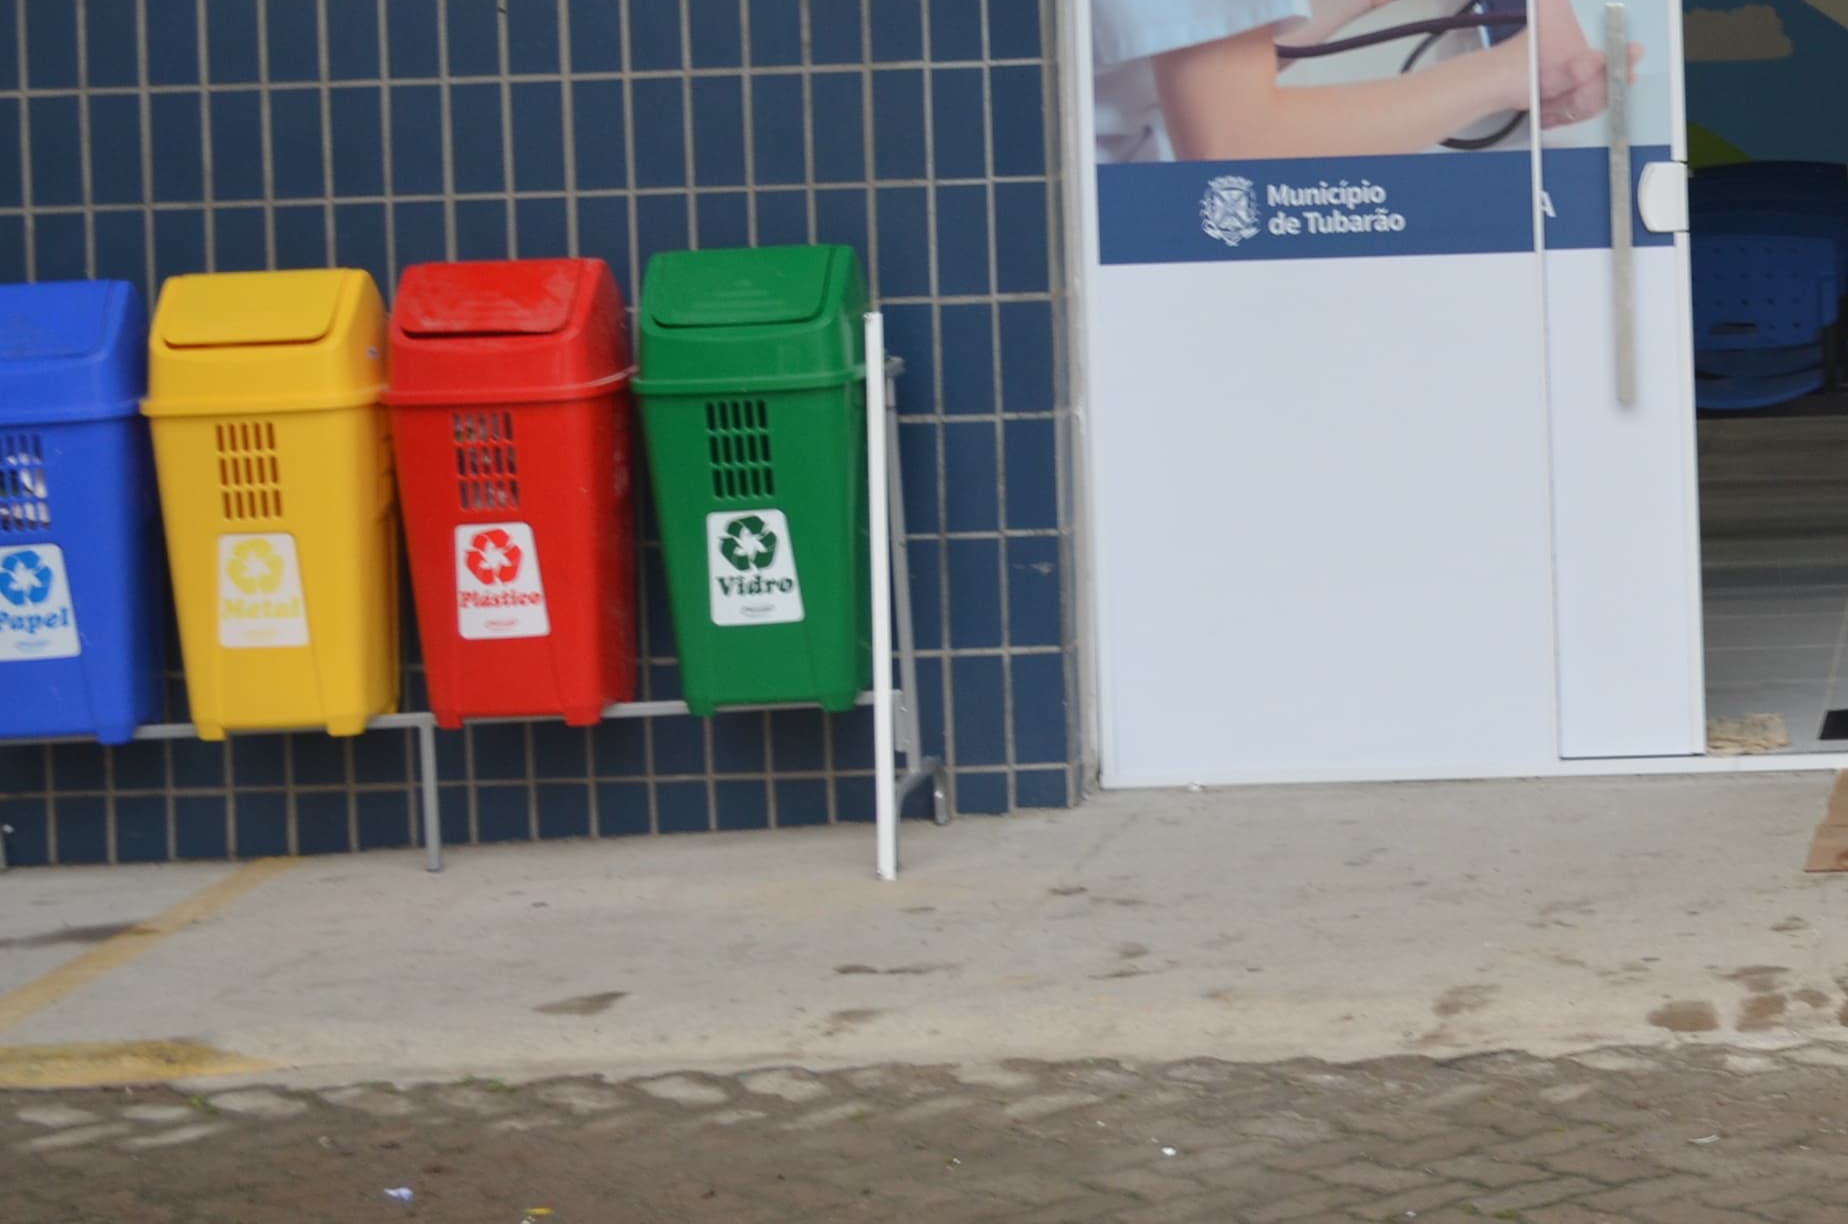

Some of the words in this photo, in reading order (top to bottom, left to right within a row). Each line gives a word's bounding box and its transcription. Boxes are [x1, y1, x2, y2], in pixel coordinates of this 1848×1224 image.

[1267, 179, 1387, 209] Município
[1268, 211, 1301, 235] de
[1302, 208, 1407, 234] Tubarão
[715, 574, 795, 596] Vidro
[223, 595, 301, 620] Metal
